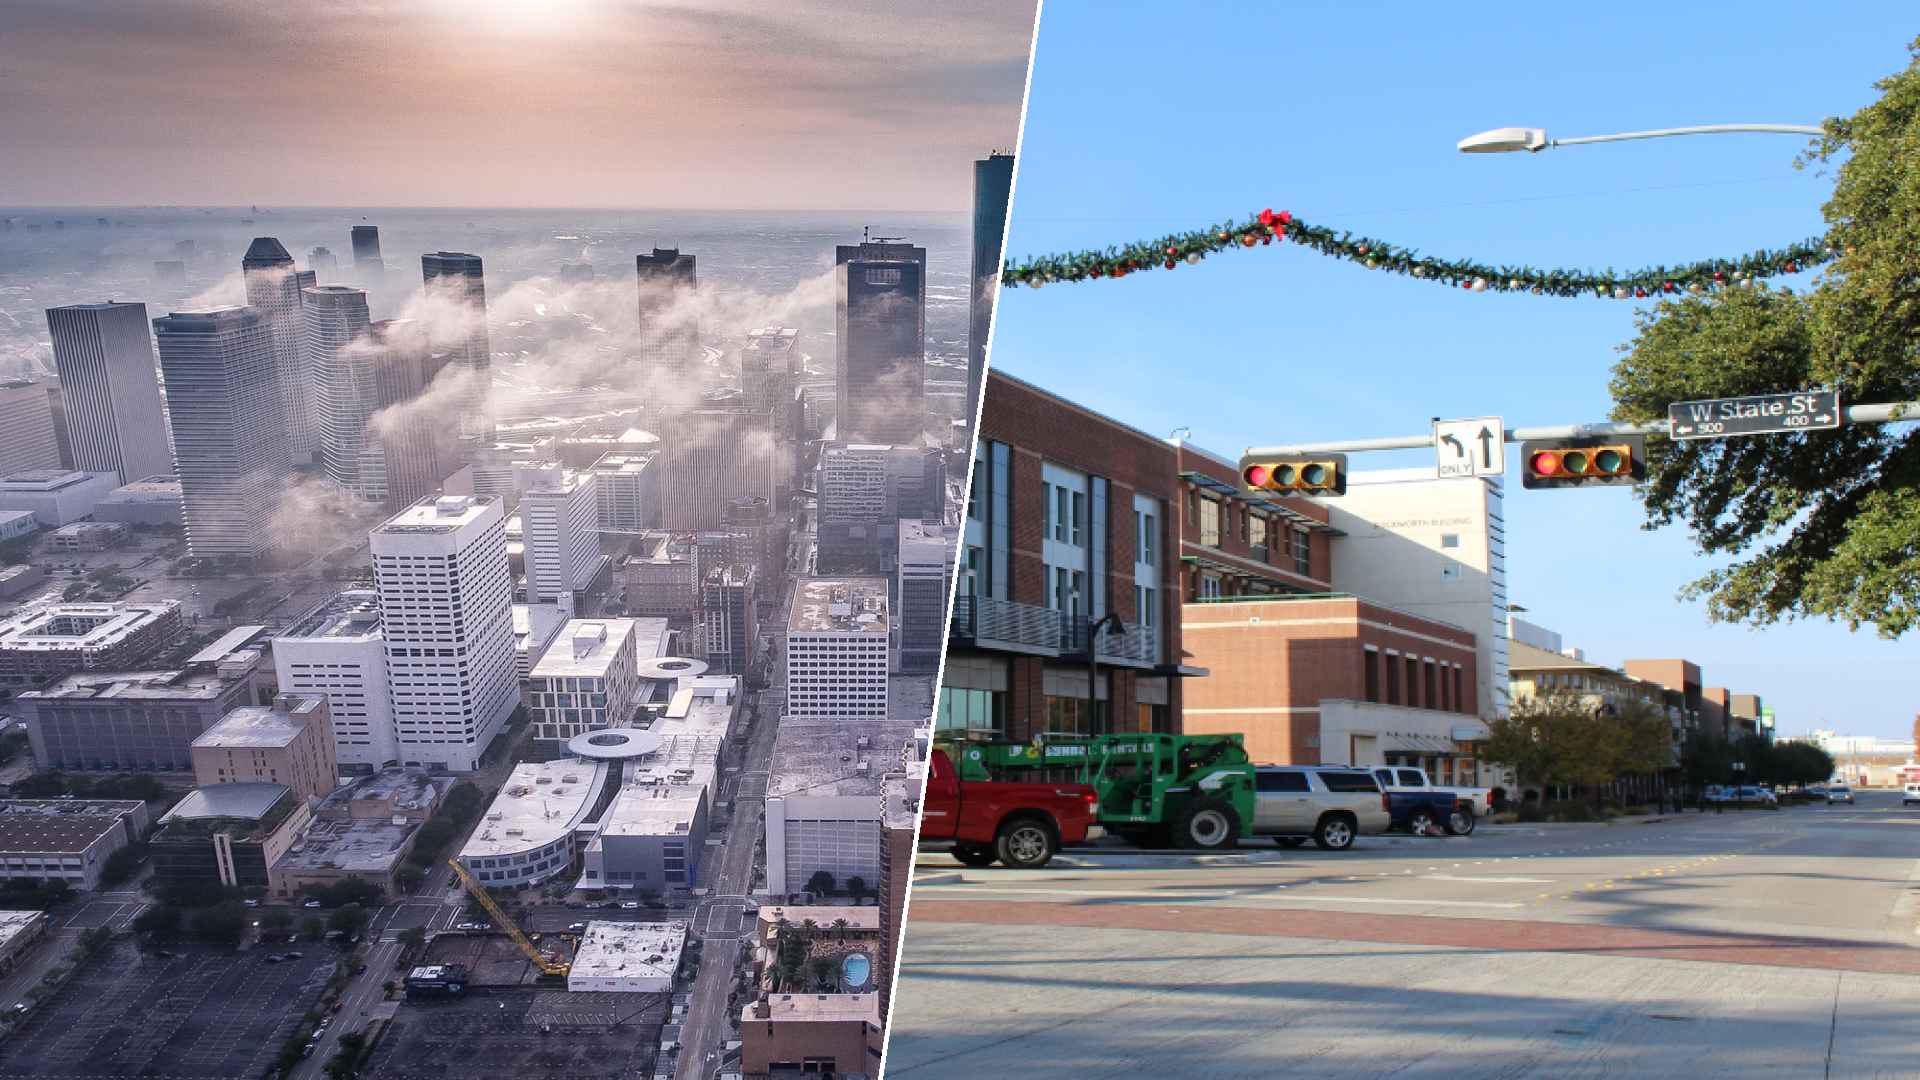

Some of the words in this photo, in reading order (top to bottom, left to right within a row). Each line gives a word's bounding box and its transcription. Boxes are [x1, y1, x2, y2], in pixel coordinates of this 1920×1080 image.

[1690, 404, 1712, 422] W
[1721, 401, 1784, 420] State
[1791, 396, 1817, 414] St
[1783, 416, 1809, 426] 400
[1440, 464, 1471, 473] ONLY
